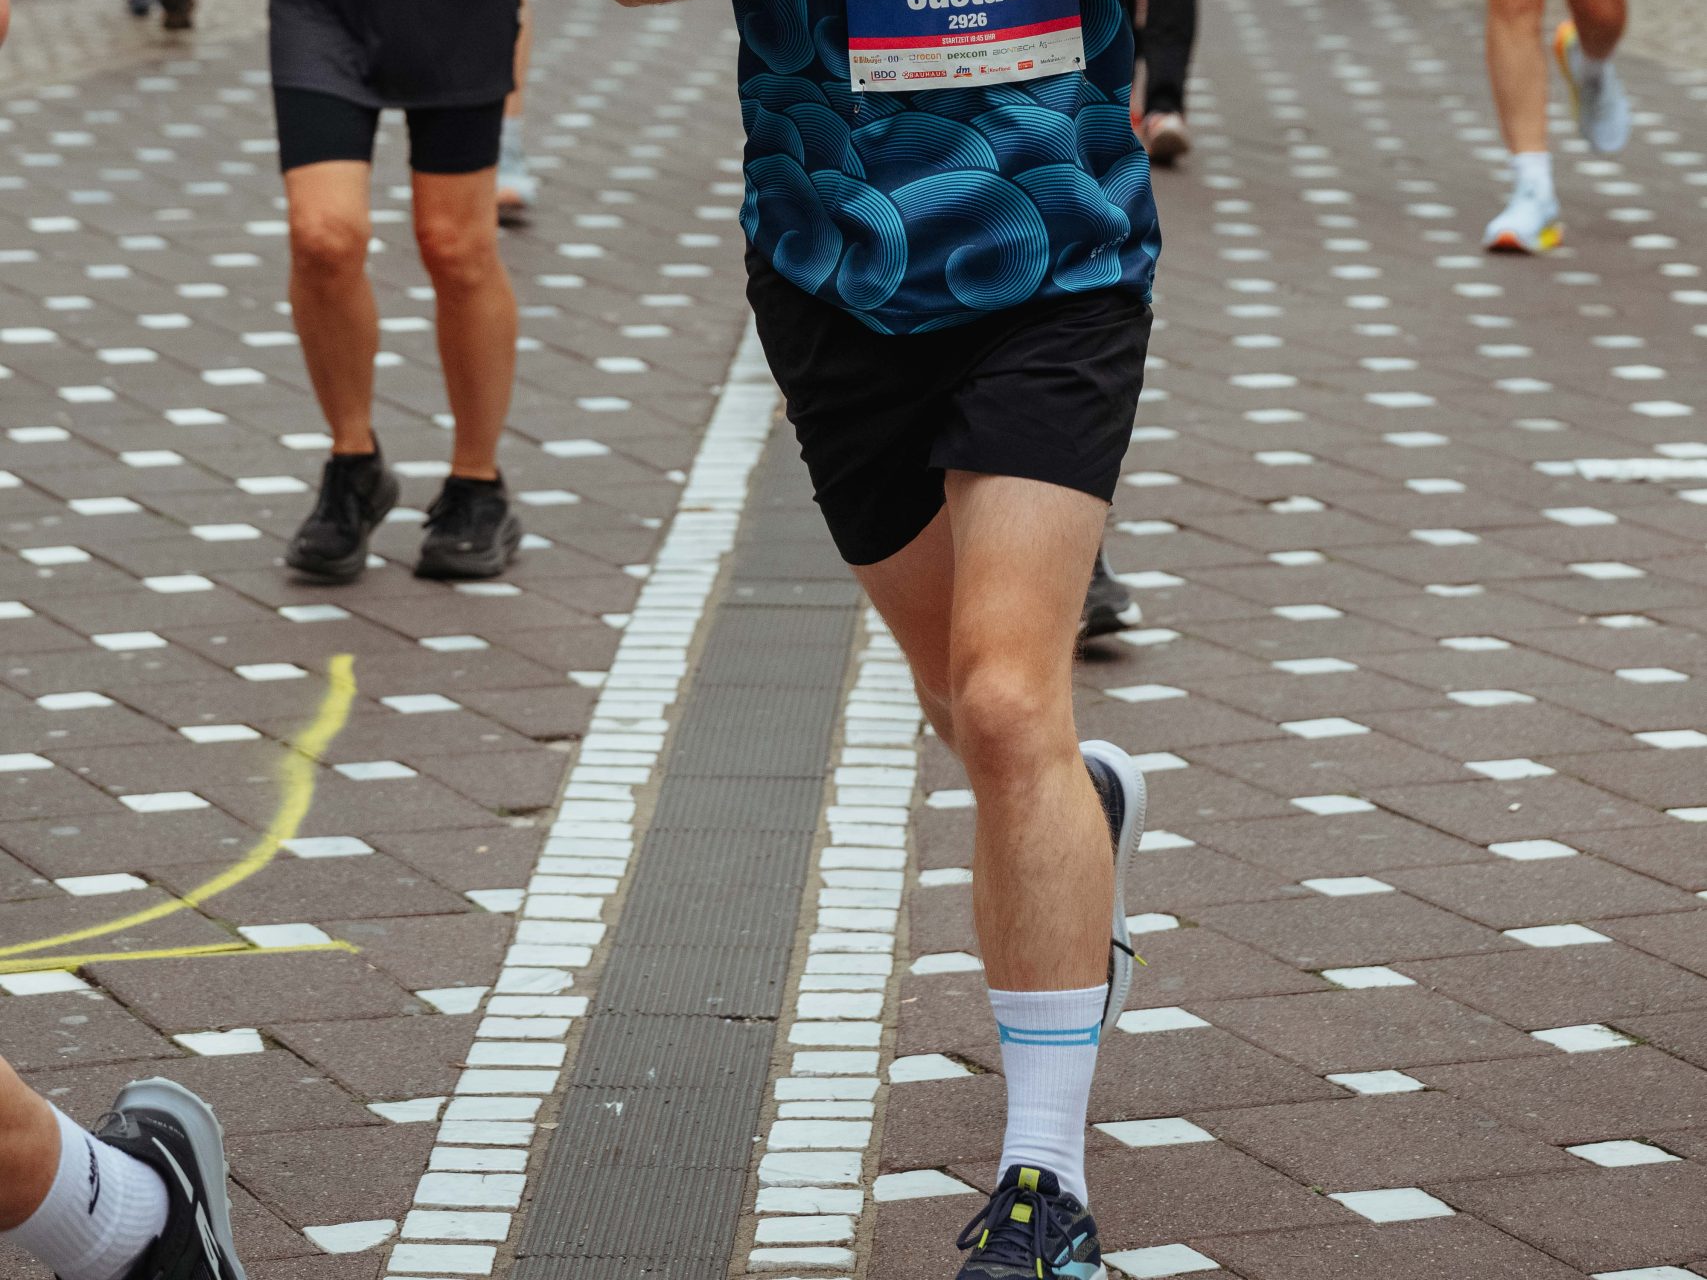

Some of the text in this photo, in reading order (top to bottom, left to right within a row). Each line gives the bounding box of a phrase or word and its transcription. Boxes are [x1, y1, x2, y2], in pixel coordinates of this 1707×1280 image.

[948, 12, 988, 30] 2926
[941, 35, 969, 45] STARTZEIT
[984, 33, 996, 41] UHR
[956, 65, 970, 74] dm
[874, 70, 897, 79] BDO
[909, 70, 946, 79] BAUHAUS
